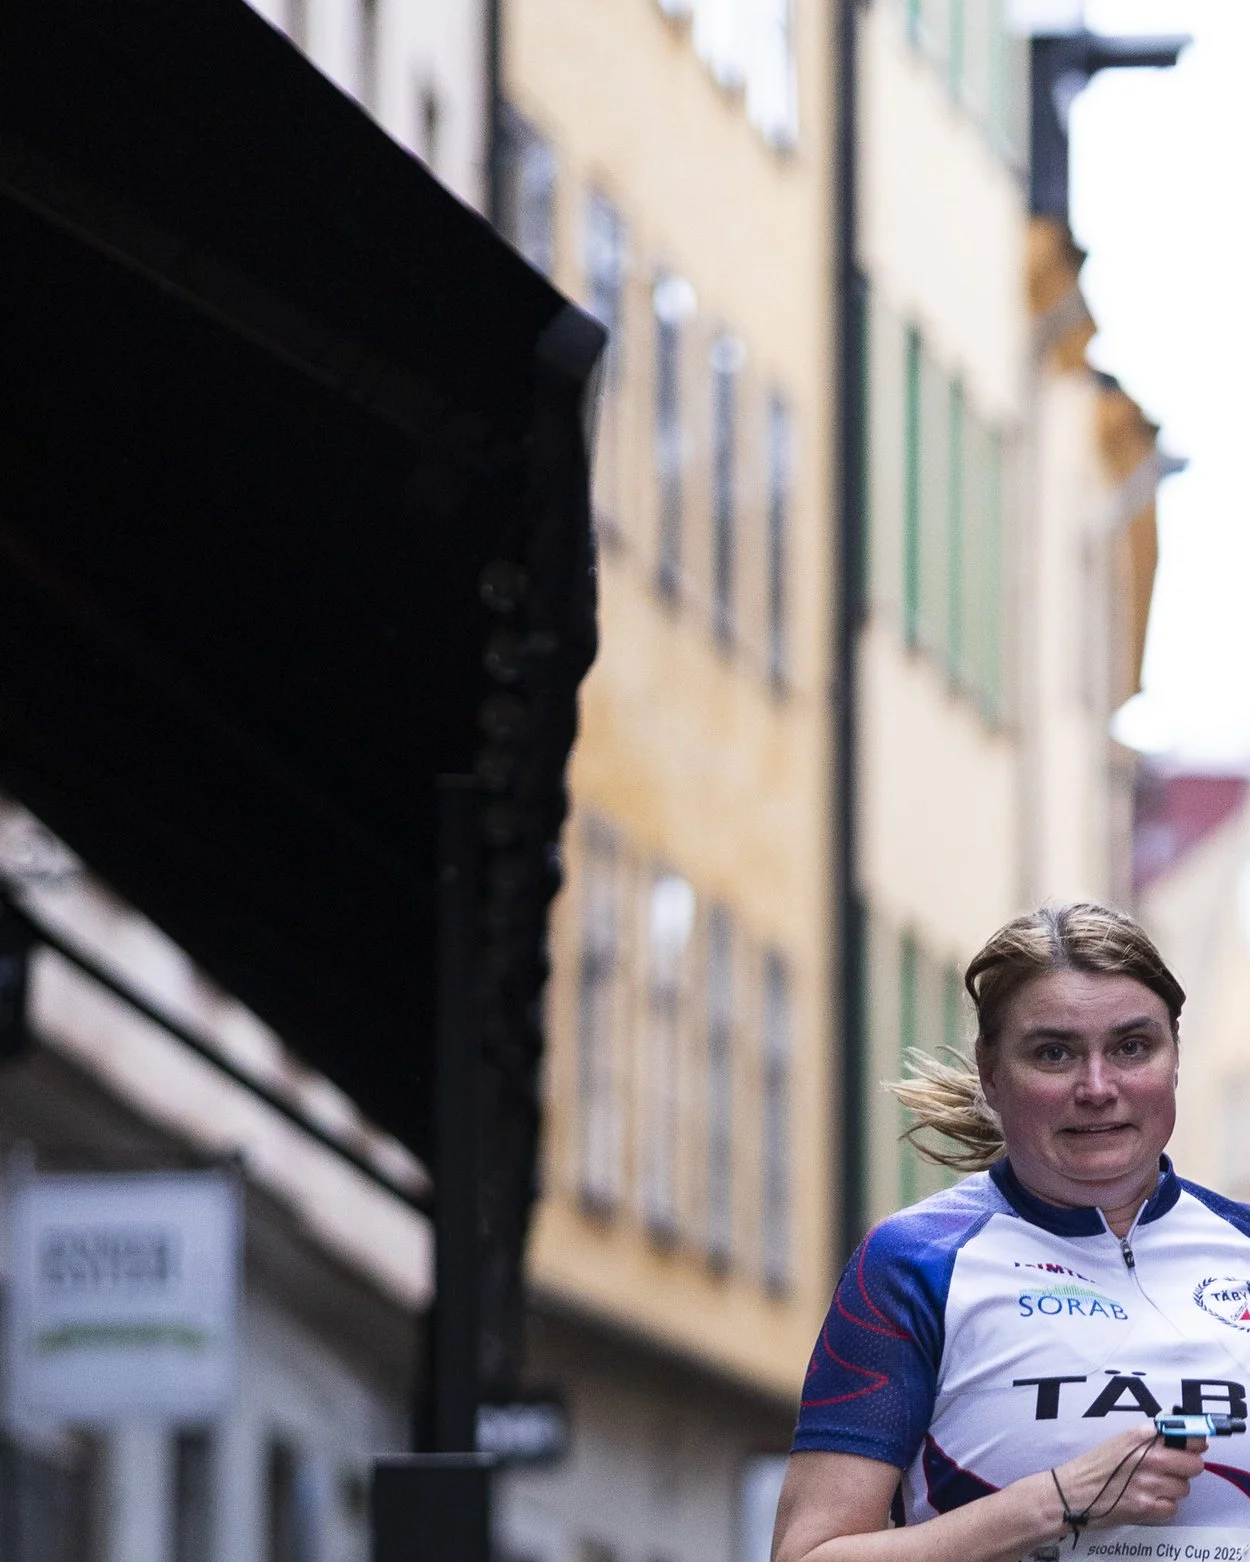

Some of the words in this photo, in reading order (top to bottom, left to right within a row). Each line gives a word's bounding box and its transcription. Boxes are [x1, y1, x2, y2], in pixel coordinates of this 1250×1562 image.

[1210, 1290, 1247, 1301] TÄBY
[1018, 1295, 1129, 1320] SORAB
[1156, 1543, 1181, 1561] City
[1185, 1544, 1210, 1562] Cup
[1213, 1546, 1243, 1561] 2025
